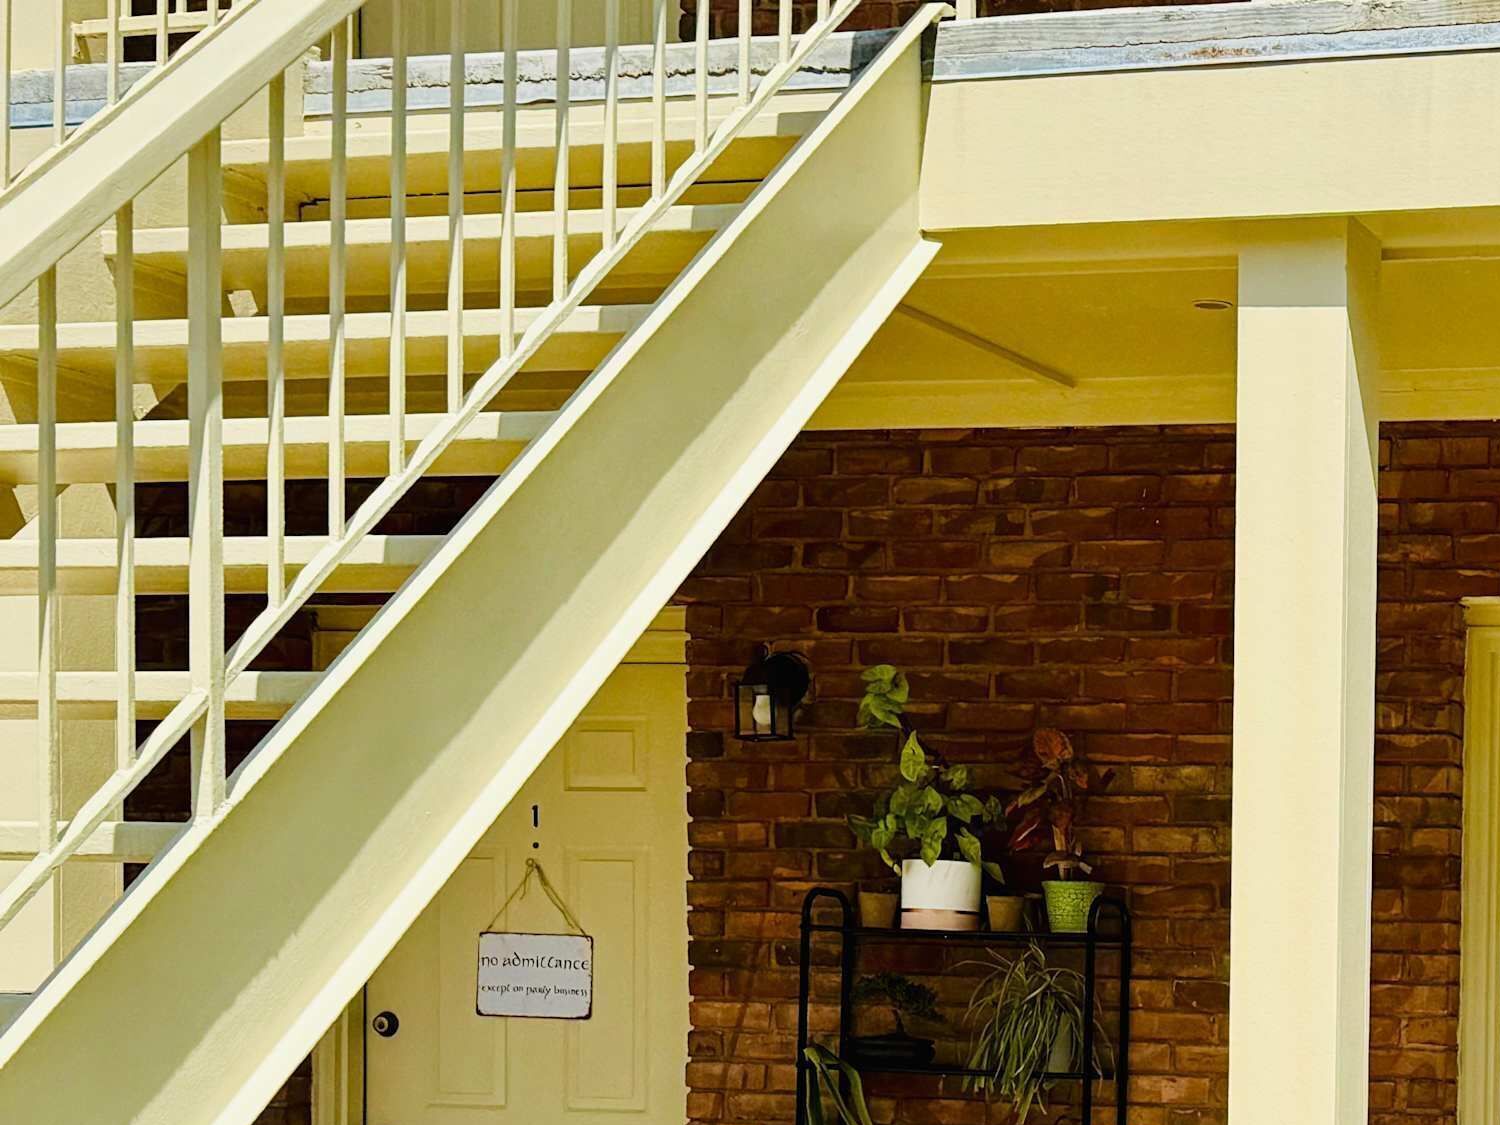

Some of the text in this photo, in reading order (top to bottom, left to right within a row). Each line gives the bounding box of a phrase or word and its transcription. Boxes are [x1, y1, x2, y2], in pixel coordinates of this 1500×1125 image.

[532, 805, 539, 828] 1
[481, 951, 590, 971] no admittance
[481, 984, 588, 1000] except on party business
